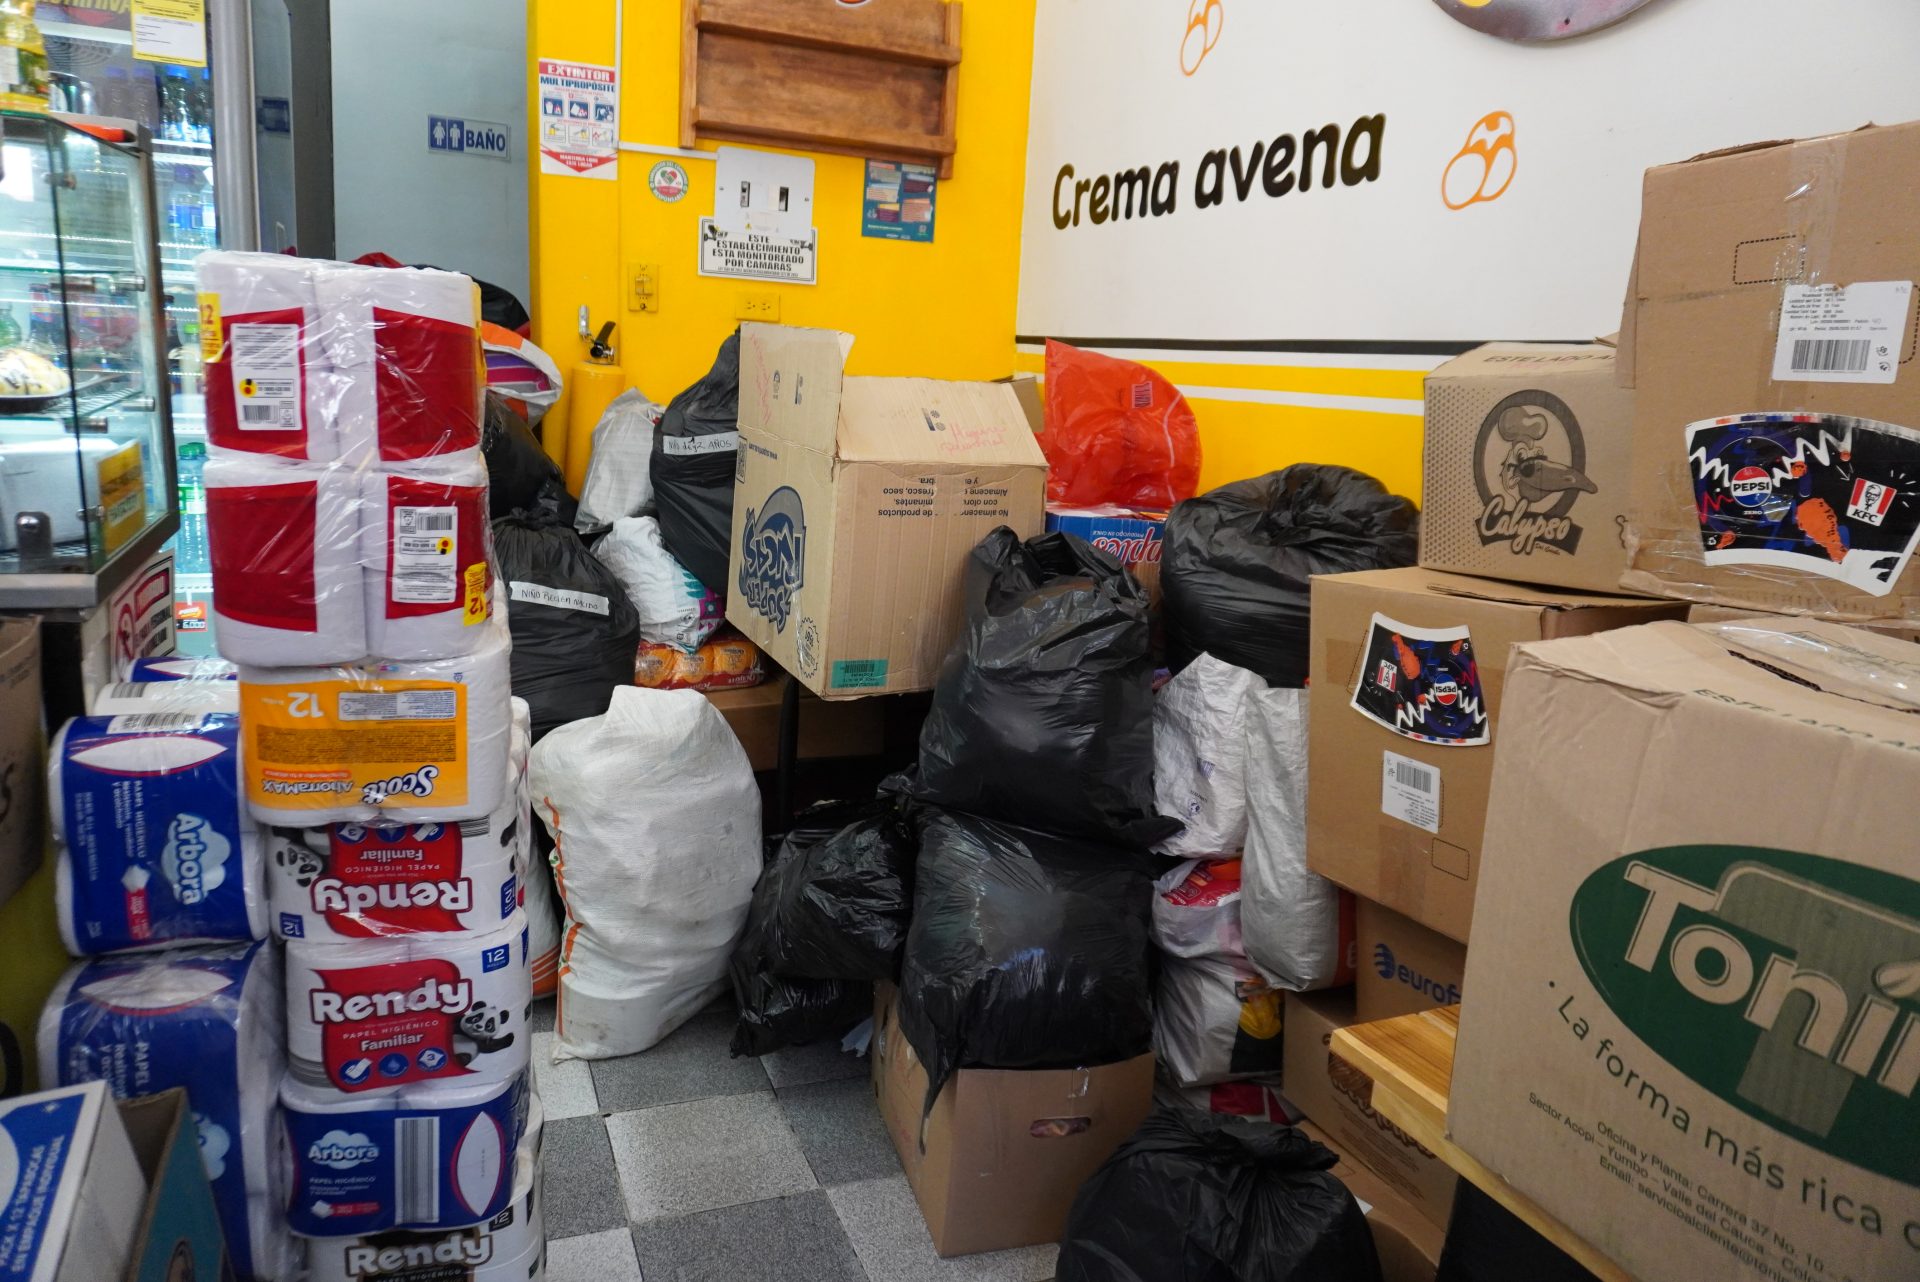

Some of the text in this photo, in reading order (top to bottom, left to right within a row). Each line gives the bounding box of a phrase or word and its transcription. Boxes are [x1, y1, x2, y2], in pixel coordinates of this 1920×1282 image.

[547, 63, 610, 82] EXTINTOR
[465, 128, 506, 152] BAÑO
[1052, 112, 1386, 230] Crema avena
[717, 240, 801, 255] ESTABLECIMIENTO
[748, 234, 769, 243] ESTE
[712, 249, 804, 264] ESTA MONITOREADO
[725, 259, 744, 268] POR
[746, 260, 792, 272] CAMARAS
[918, 477, 936, 485] bra.
[1733, 482, 1770, 492] PEPSI
[1481, 494, 1572, 555] Calypso
[1851, 508, 1878, 523] KFC
[743, 519, 805, 588] RICAS
[521, 588, 540, 599] NIÑO
[747, 578, 791, 633] SUPER
[287, 692, 324, 718] 12
[262, 780, 353, 795] AhorraMAX
[361, 766, 438, 805] Scott
[176, 812, 207, 906] Arbora
[360, 849, 423, 863] Familiar
[345, 865, 403, 874] HIGIÉNICO
[314, 878, 471, 914] Rendy
[486, 948, 505, 963] 12
[1398, 964, 1461, 1006] eurof
[1624, 860, 1920, 1098] Toni
[311, 977, 470, 1023] Rendy
[343, 1019, 439, 1040] PAPEL HIGIÉNICO
[361, 1033, 423, 1052] Familiar
[136, 1041, 150, 1092] PAPEL
[1557, 995, 1589, 1041] La
[1595, 1038, 1691, 1133] forma
[1704, 1126, 1786, 1192] más
[1801, 1176, 1883, 1236] rica
[308, 1143, 380, 1161] Arbora
[1529, 1092, 1561, 1121] Sector
[1563, 1116, 1595, 1144] Acopi
[1607, 1145, 1649, 1179] Yumbo
[1662, 1179, 1693, 1207] Valle
[1696, 1204, 1717, 1223] del
[1719, 1216, 1765, 1255] Cauca
[1597, 1121, 1637, 1155] Oficina
[1651, 1154, 1693, 1190] Planta:
[1697, 1184, 1747, 1224] Carrera
[1599, 1155, 1634, 1189] Email:
[351, 1231, 492, 1276] Rendy
